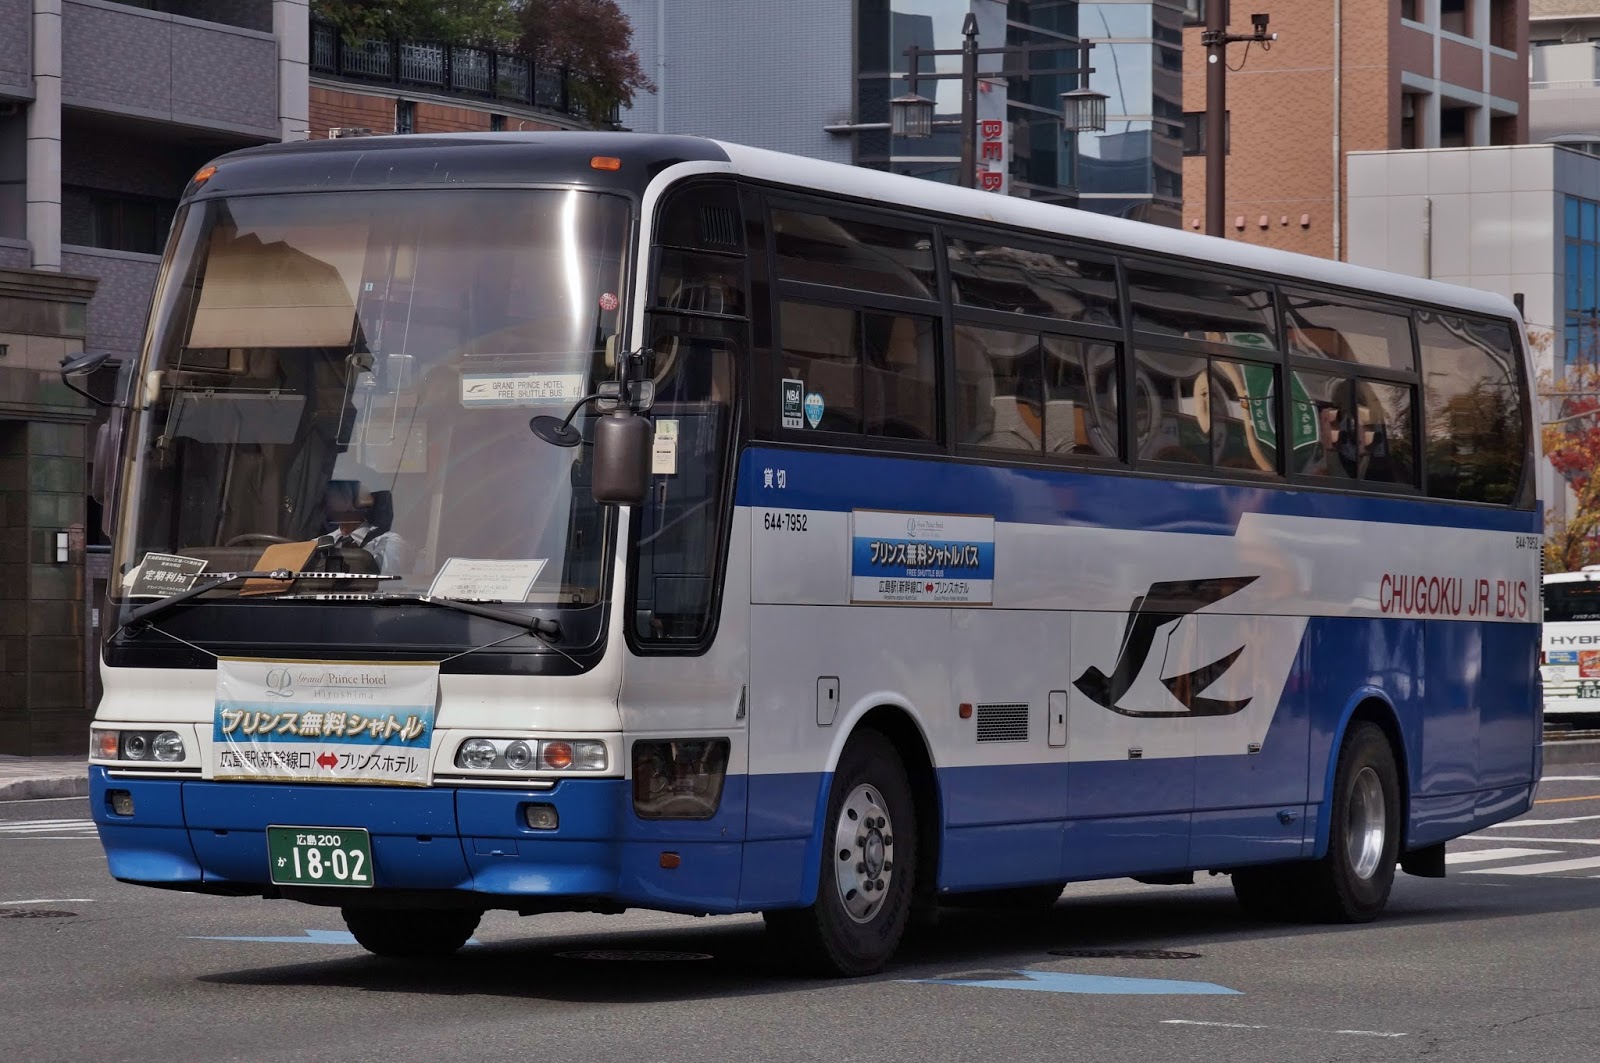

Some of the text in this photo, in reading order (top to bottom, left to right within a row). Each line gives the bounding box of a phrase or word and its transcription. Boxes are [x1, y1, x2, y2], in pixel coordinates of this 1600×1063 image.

[492, 380, 564, 390] GRAND PRINCE HOTEL
[498, 390, 514, 398] FREE
[518, 389, 546, 397] SHUTTLE
[549, 389, 563, 397] BUS
[786, 389, 800, 401] NBA
[764, 512, 808, 532] 644-7952
[1515, 536, 1539, 550] 644-7952
[870, 541, 979, 567] プリンス無料シャトルバス
[143, 569, 187, 583] 定期利用
[906, 569, 917, 577] FREE
[918, 569, 935, 577] SHUTTLE
[934, 581, 970, 594] プリンスホテル
[1379, 573, 1527, 618] CHUGOKU JR BUS
[296, 672, 387, 685] Grand Prince Hotel
[313, 689, 375, 700] Hiroshima
[221, 709, 424, 741] プリンス無料シャトル
[339, 752, 419, 774] プリンスホテル
[292, 846, 367, 881] 18-02
